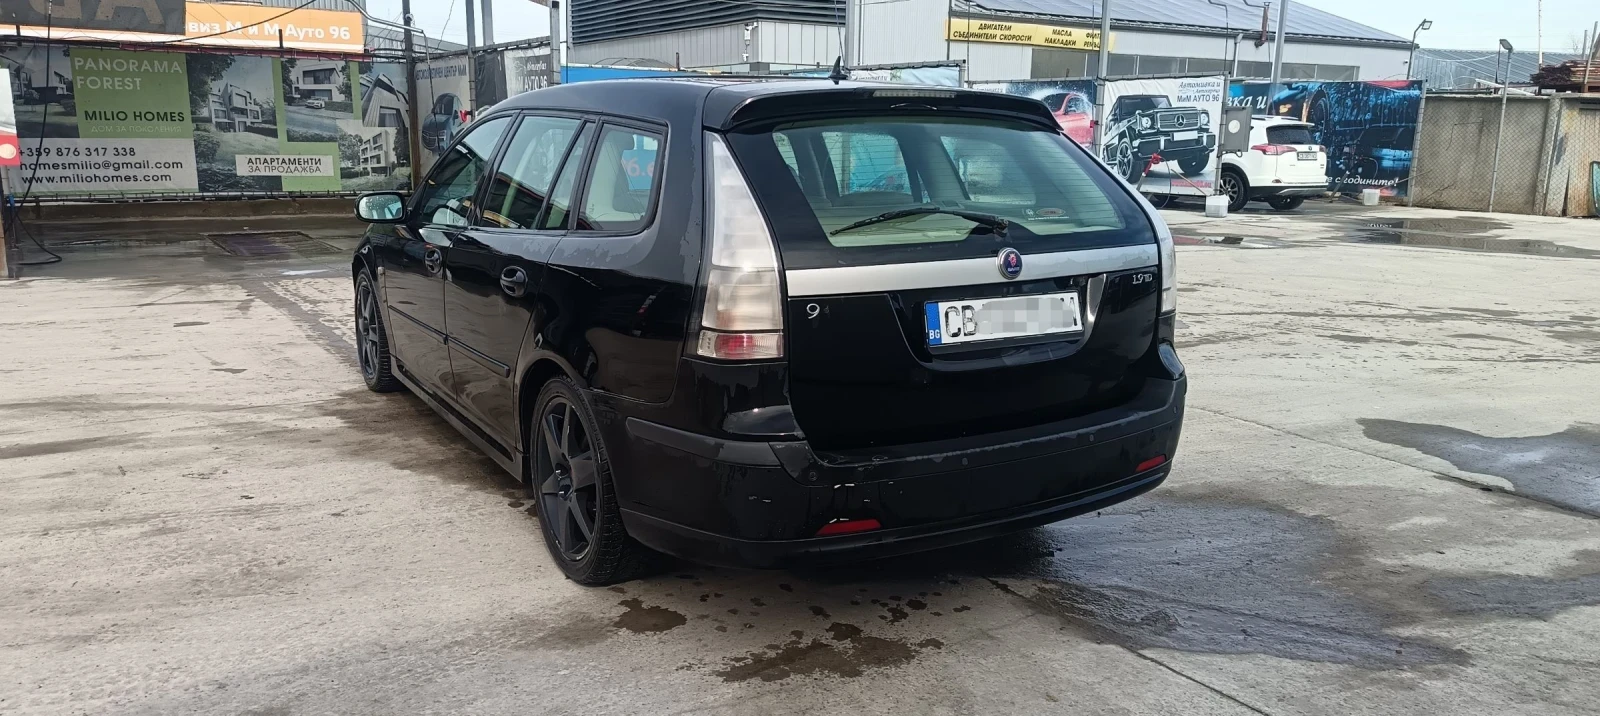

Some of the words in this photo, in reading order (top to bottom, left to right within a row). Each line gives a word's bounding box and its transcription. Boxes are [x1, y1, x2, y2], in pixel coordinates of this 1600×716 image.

[226, 21, 242, 34] М
[248, 25, 258, 35] и
[264, 22, 279, 36] М
[285, 24, 325, 40] Ауто
[329, 25, 351, 40] 96
[978, 23, 1012, 31] ДВИГАТЕЛИ
[953, 31, 997, 40] СЪЕДИНИТЕЛИ
[999, 33, 1032, 42] СКОРОСТИ
[1052, 29, 1072, 37] МАСЛА
[1044, 37, 1077, 46] НАКЛАДКИ
[74, 57, 182, 73] PANORAMA
[76, 76, 142, 90] FOREST
[1193, 94, 1211, 102] АУТО
[1211, 94, 1220, 102] 96
[84, 110, 128, 121] MILIO
[133, 111, 185, 122] HOMES
[91, 125, 113, 133] ДОМ
[19, 147, 51, 157] +359
[56, 147, 80, 157] 876
[85, 147, 108, 157] 317
[113, 147, 136, 157] 338
[247, 157, 322, 165] АПАРТАМЕНТИ
[248, 165, 261, 173] ЗА
[264, 165, 322, 174] ПРОДАЖБА
[21, 174, 171, 184] www.miliohomes.com
[1343, 175, 1399, 187] годините!
[806, 303, 820, 319] 9
[929, 329, 941, 340] BG
